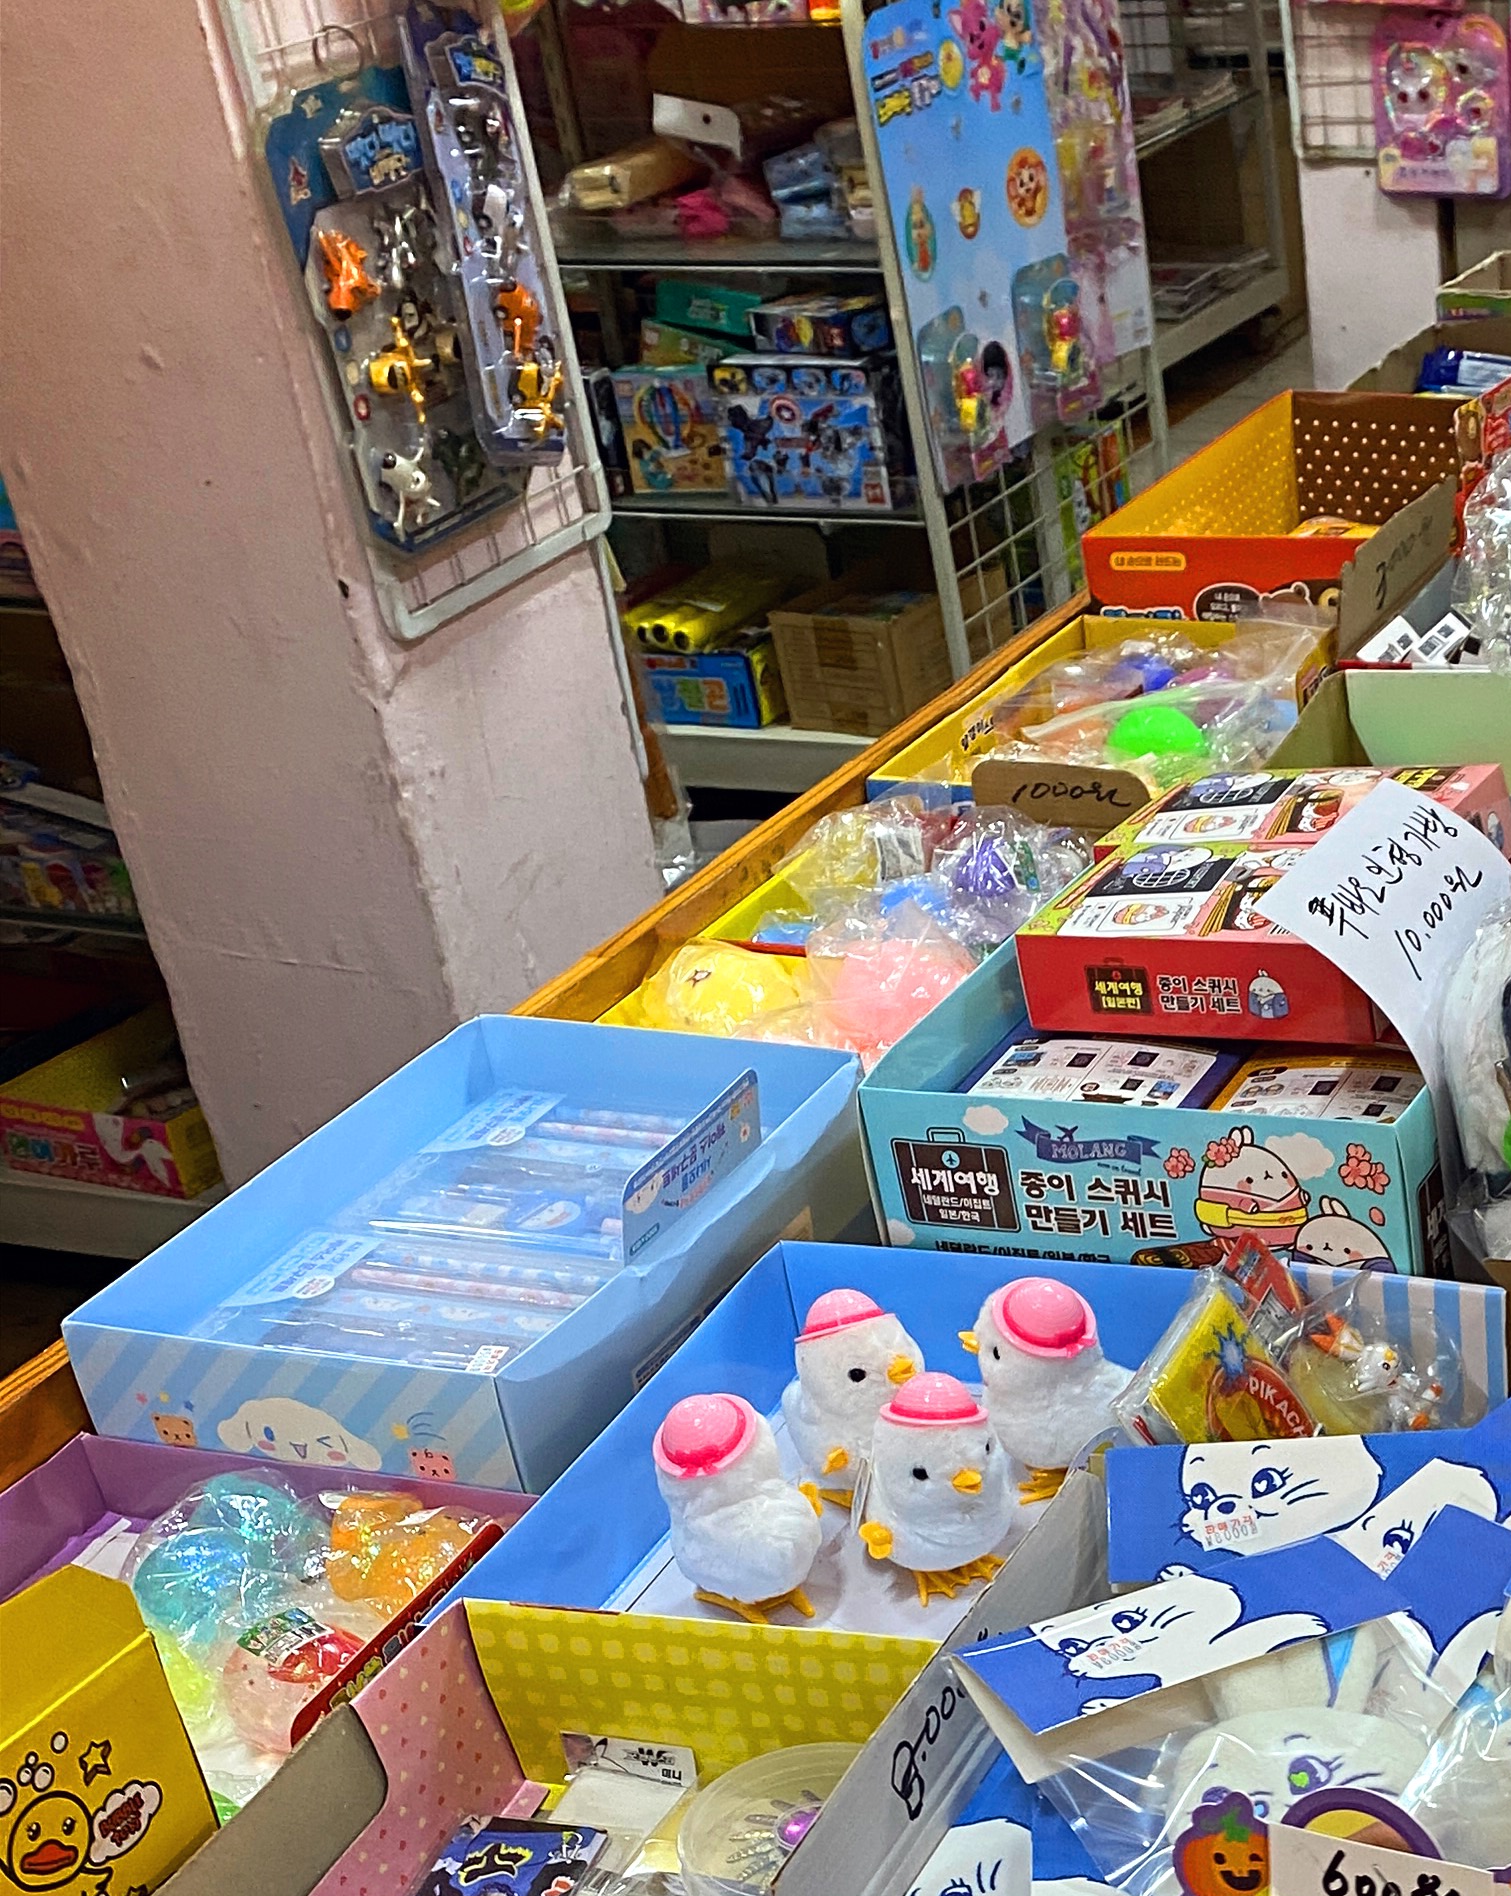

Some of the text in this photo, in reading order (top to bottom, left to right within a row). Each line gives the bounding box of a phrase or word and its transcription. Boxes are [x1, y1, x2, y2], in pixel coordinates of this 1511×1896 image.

[1012, 781, 1131, 807] 1000원
[1095, 980, 1143, 995] 세계여행
[1157, 976, 1238, 996] 종이 스퀴시
[1160, 995, 1243, 1013] 만들기 세트
[1051, 1141, 1128, 1161] MOLANG
[910, 1166, 1000, 1196] 세계여행
[1020, 1171, 1172, 1209] 종이 스퀴시
[923, 1194, 992, 1211] 네덜란드/이집트
[939, 1208, 981, 1223] 일본/한국
[1026, 1204, 1179, 1240] 만들기 세트
[1205, 1515, 1254, 1536] 판매가격
[1087, 1637, 1130, 1662] 판매가격
